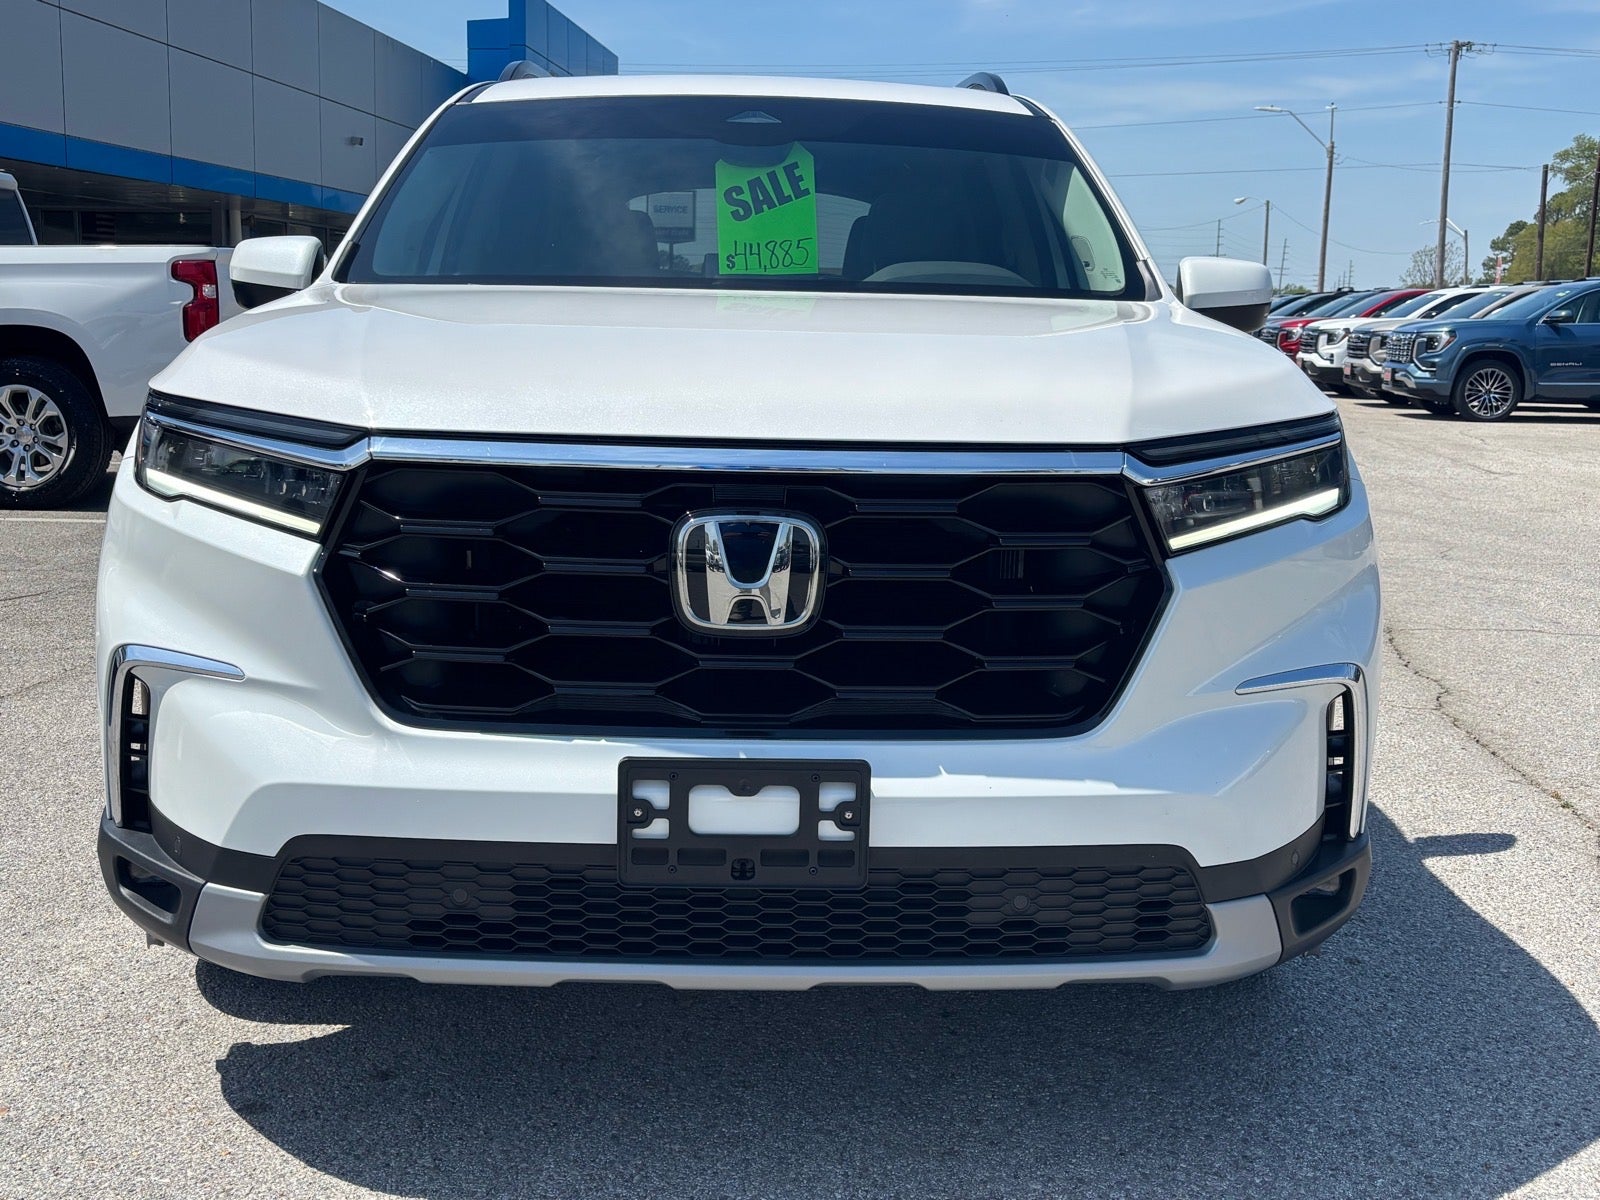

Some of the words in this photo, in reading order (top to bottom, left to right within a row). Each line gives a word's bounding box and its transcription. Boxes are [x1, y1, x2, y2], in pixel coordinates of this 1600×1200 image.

[723, 161, 811, 222] SALE
[653, 204, 689, 215] SERVICE
[726, 237, 813, 272] $44,885
